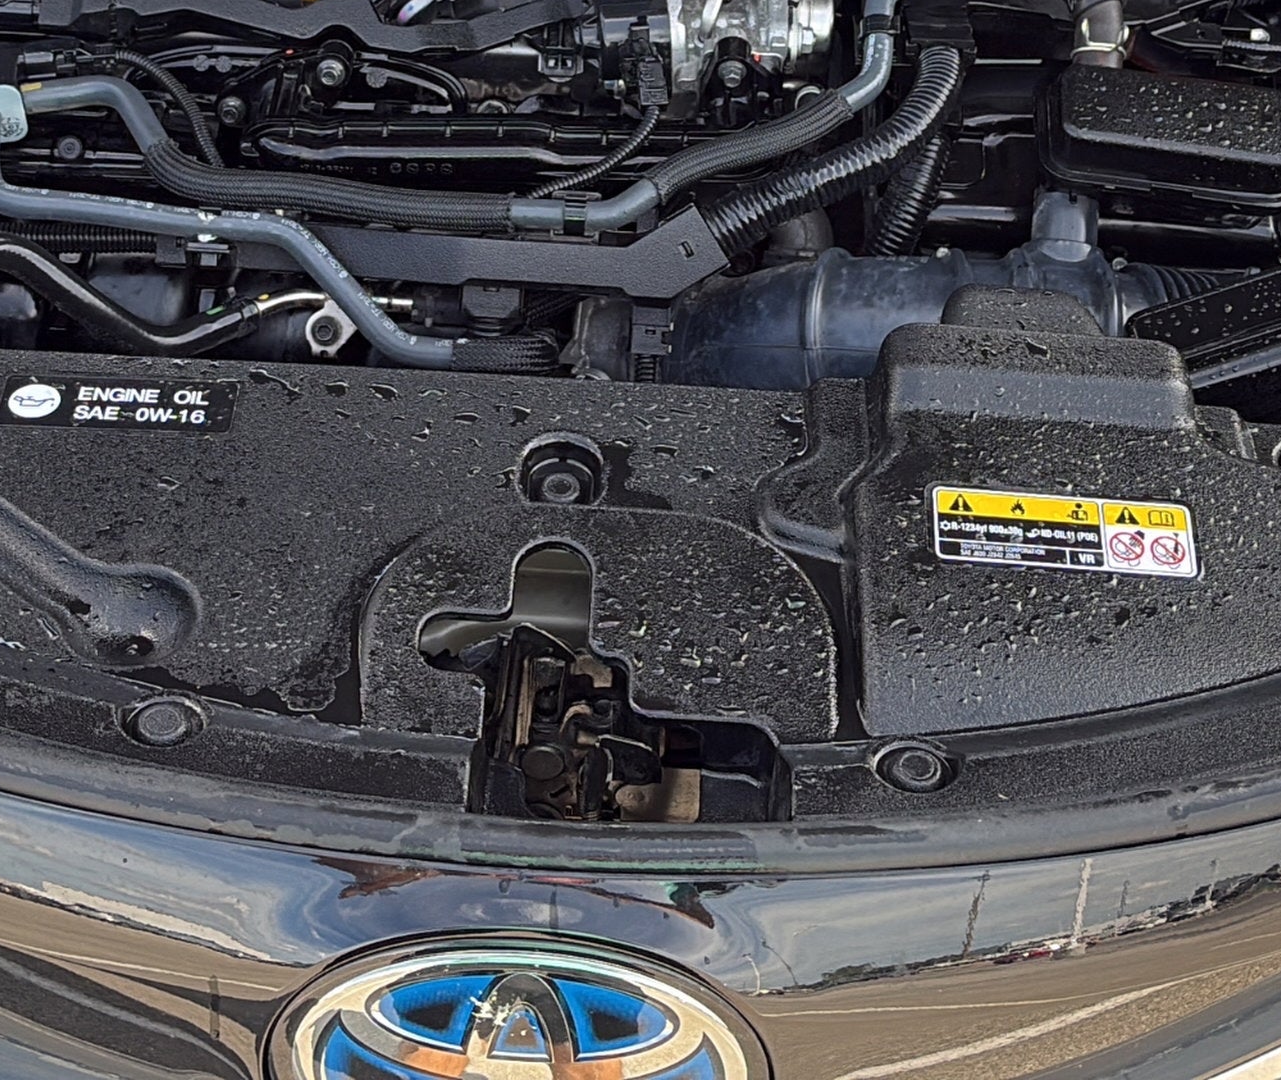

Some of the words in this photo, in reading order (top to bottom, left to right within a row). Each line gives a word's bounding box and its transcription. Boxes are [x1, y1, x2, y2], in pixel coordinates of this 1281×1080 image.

[77, 386, 160, 404] ENGINE
[173, 390, 210, 406] OIL
[73, 405, 120, 420] SAE
[135, 408, 206, 424] 0W-16
[1076, 531, 1099, 543] (POE)
[960, 542, 983, 550] TOYOTA
[983, 544, 1004, 552] MOTOR
[1004, 546, 1046, 556] CORPORATION
[1078, 553, 1096, 564] VR
